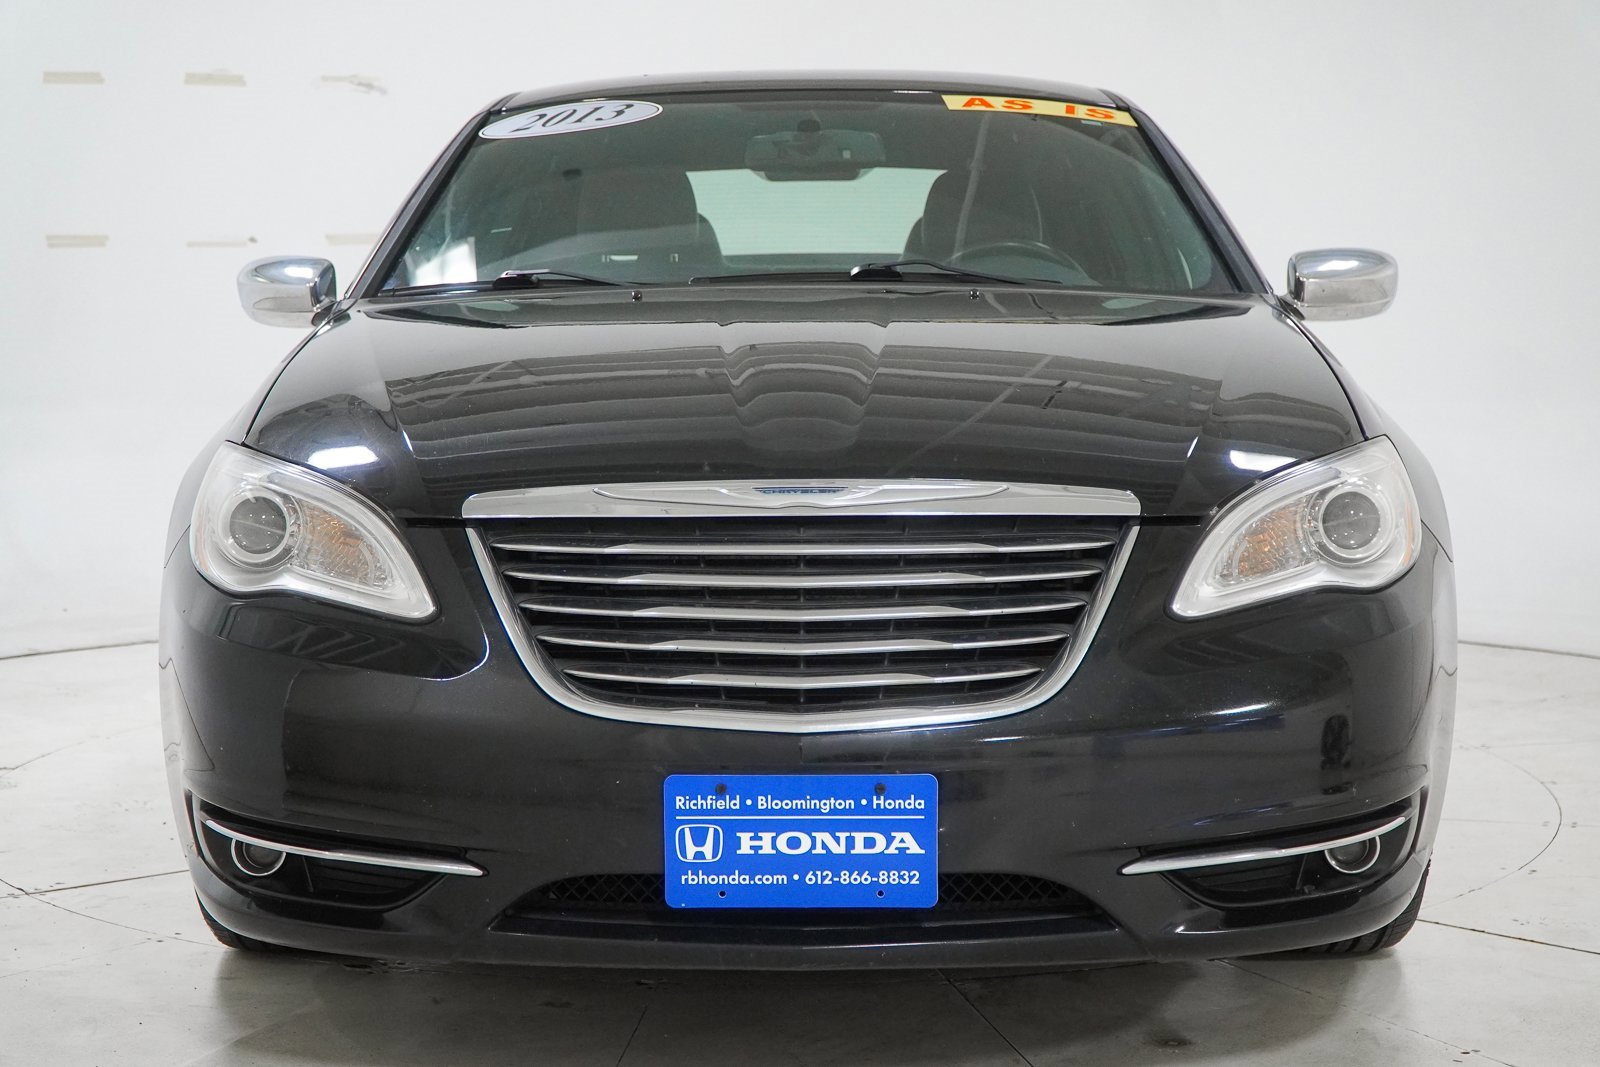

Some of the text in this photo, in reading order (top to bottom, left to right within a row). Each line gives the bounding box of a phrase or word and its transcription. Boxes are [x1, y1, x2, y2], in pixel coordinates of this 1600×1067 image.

[510, 103, 635, 133] 2013
[962, 97, 1115, 120] AS IS
[675, 795, 925, 813] Richfield Bloomington Honda
[736, 831, 926, 855] HONDA
[681, 870, 920, 885] rbhonda.com 612-866-8832
